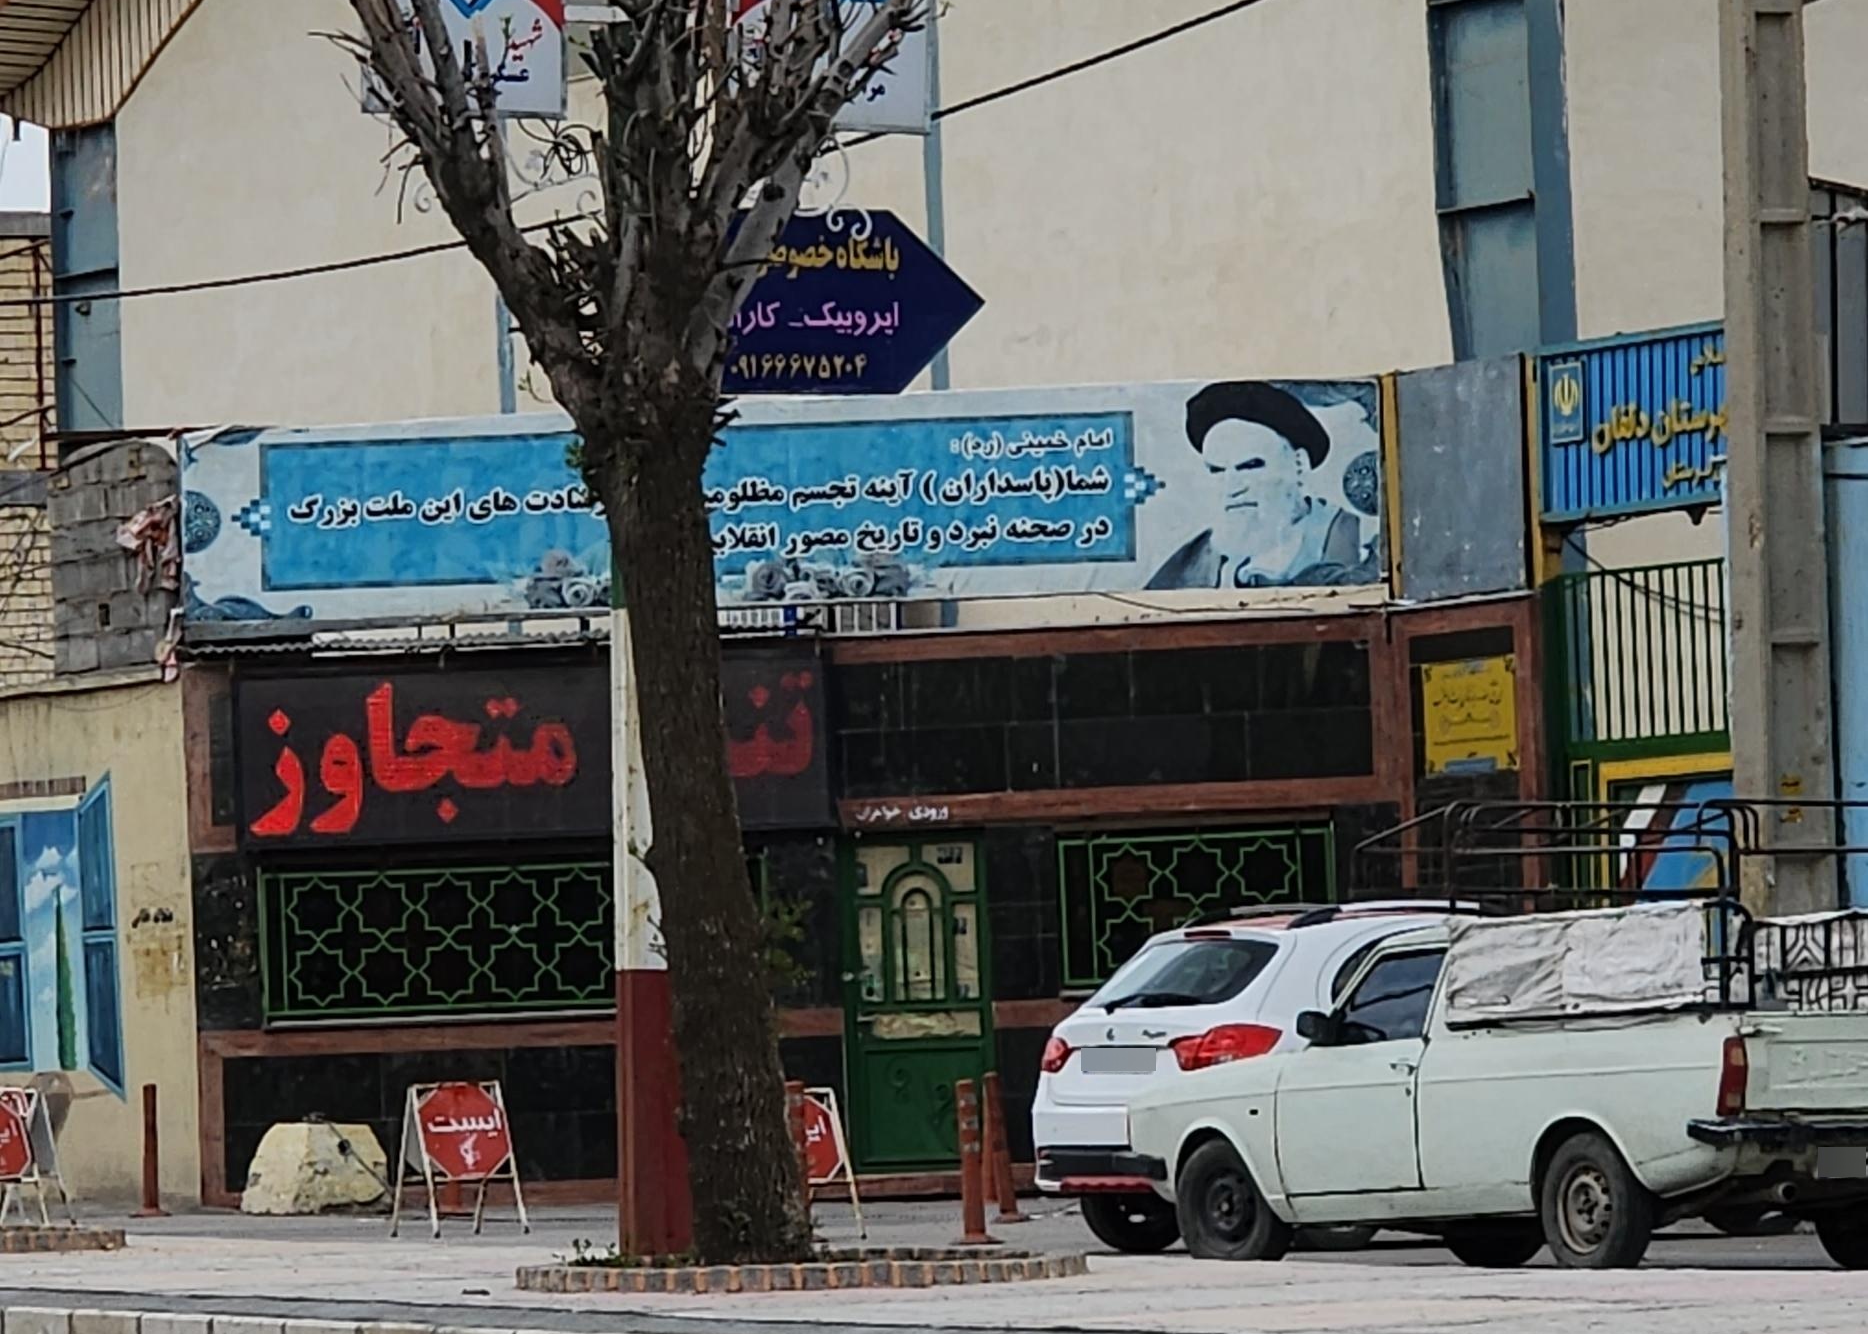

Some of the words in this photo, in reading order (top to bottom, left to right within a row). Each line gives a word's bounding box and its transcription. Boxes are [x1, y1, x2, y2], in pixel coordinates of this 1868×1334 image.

[1006, 431, 1070, 458] خمینی
[1073, 428, 1113, 457] امام
[790, 475, 859, 512] تجسم
[863, 469, 915, 507] آینه
[363, 490, 416, 521] ملت
[418, 487, 464, 526] این
[466, 487, 518, 524] های
[781, 526, 853, 557] مصور
[855, 517, 923, 555] تاریخ
[926, 526, 944, 555] و
[947, 514, 1000, 552] نبرد
[1003, 515, 1075, 542] صحنه
[1075, 516, 1113, 548] در
[250, 681, 577, 836] متجاوز
[426, 1107, 502, 1138] ایست
